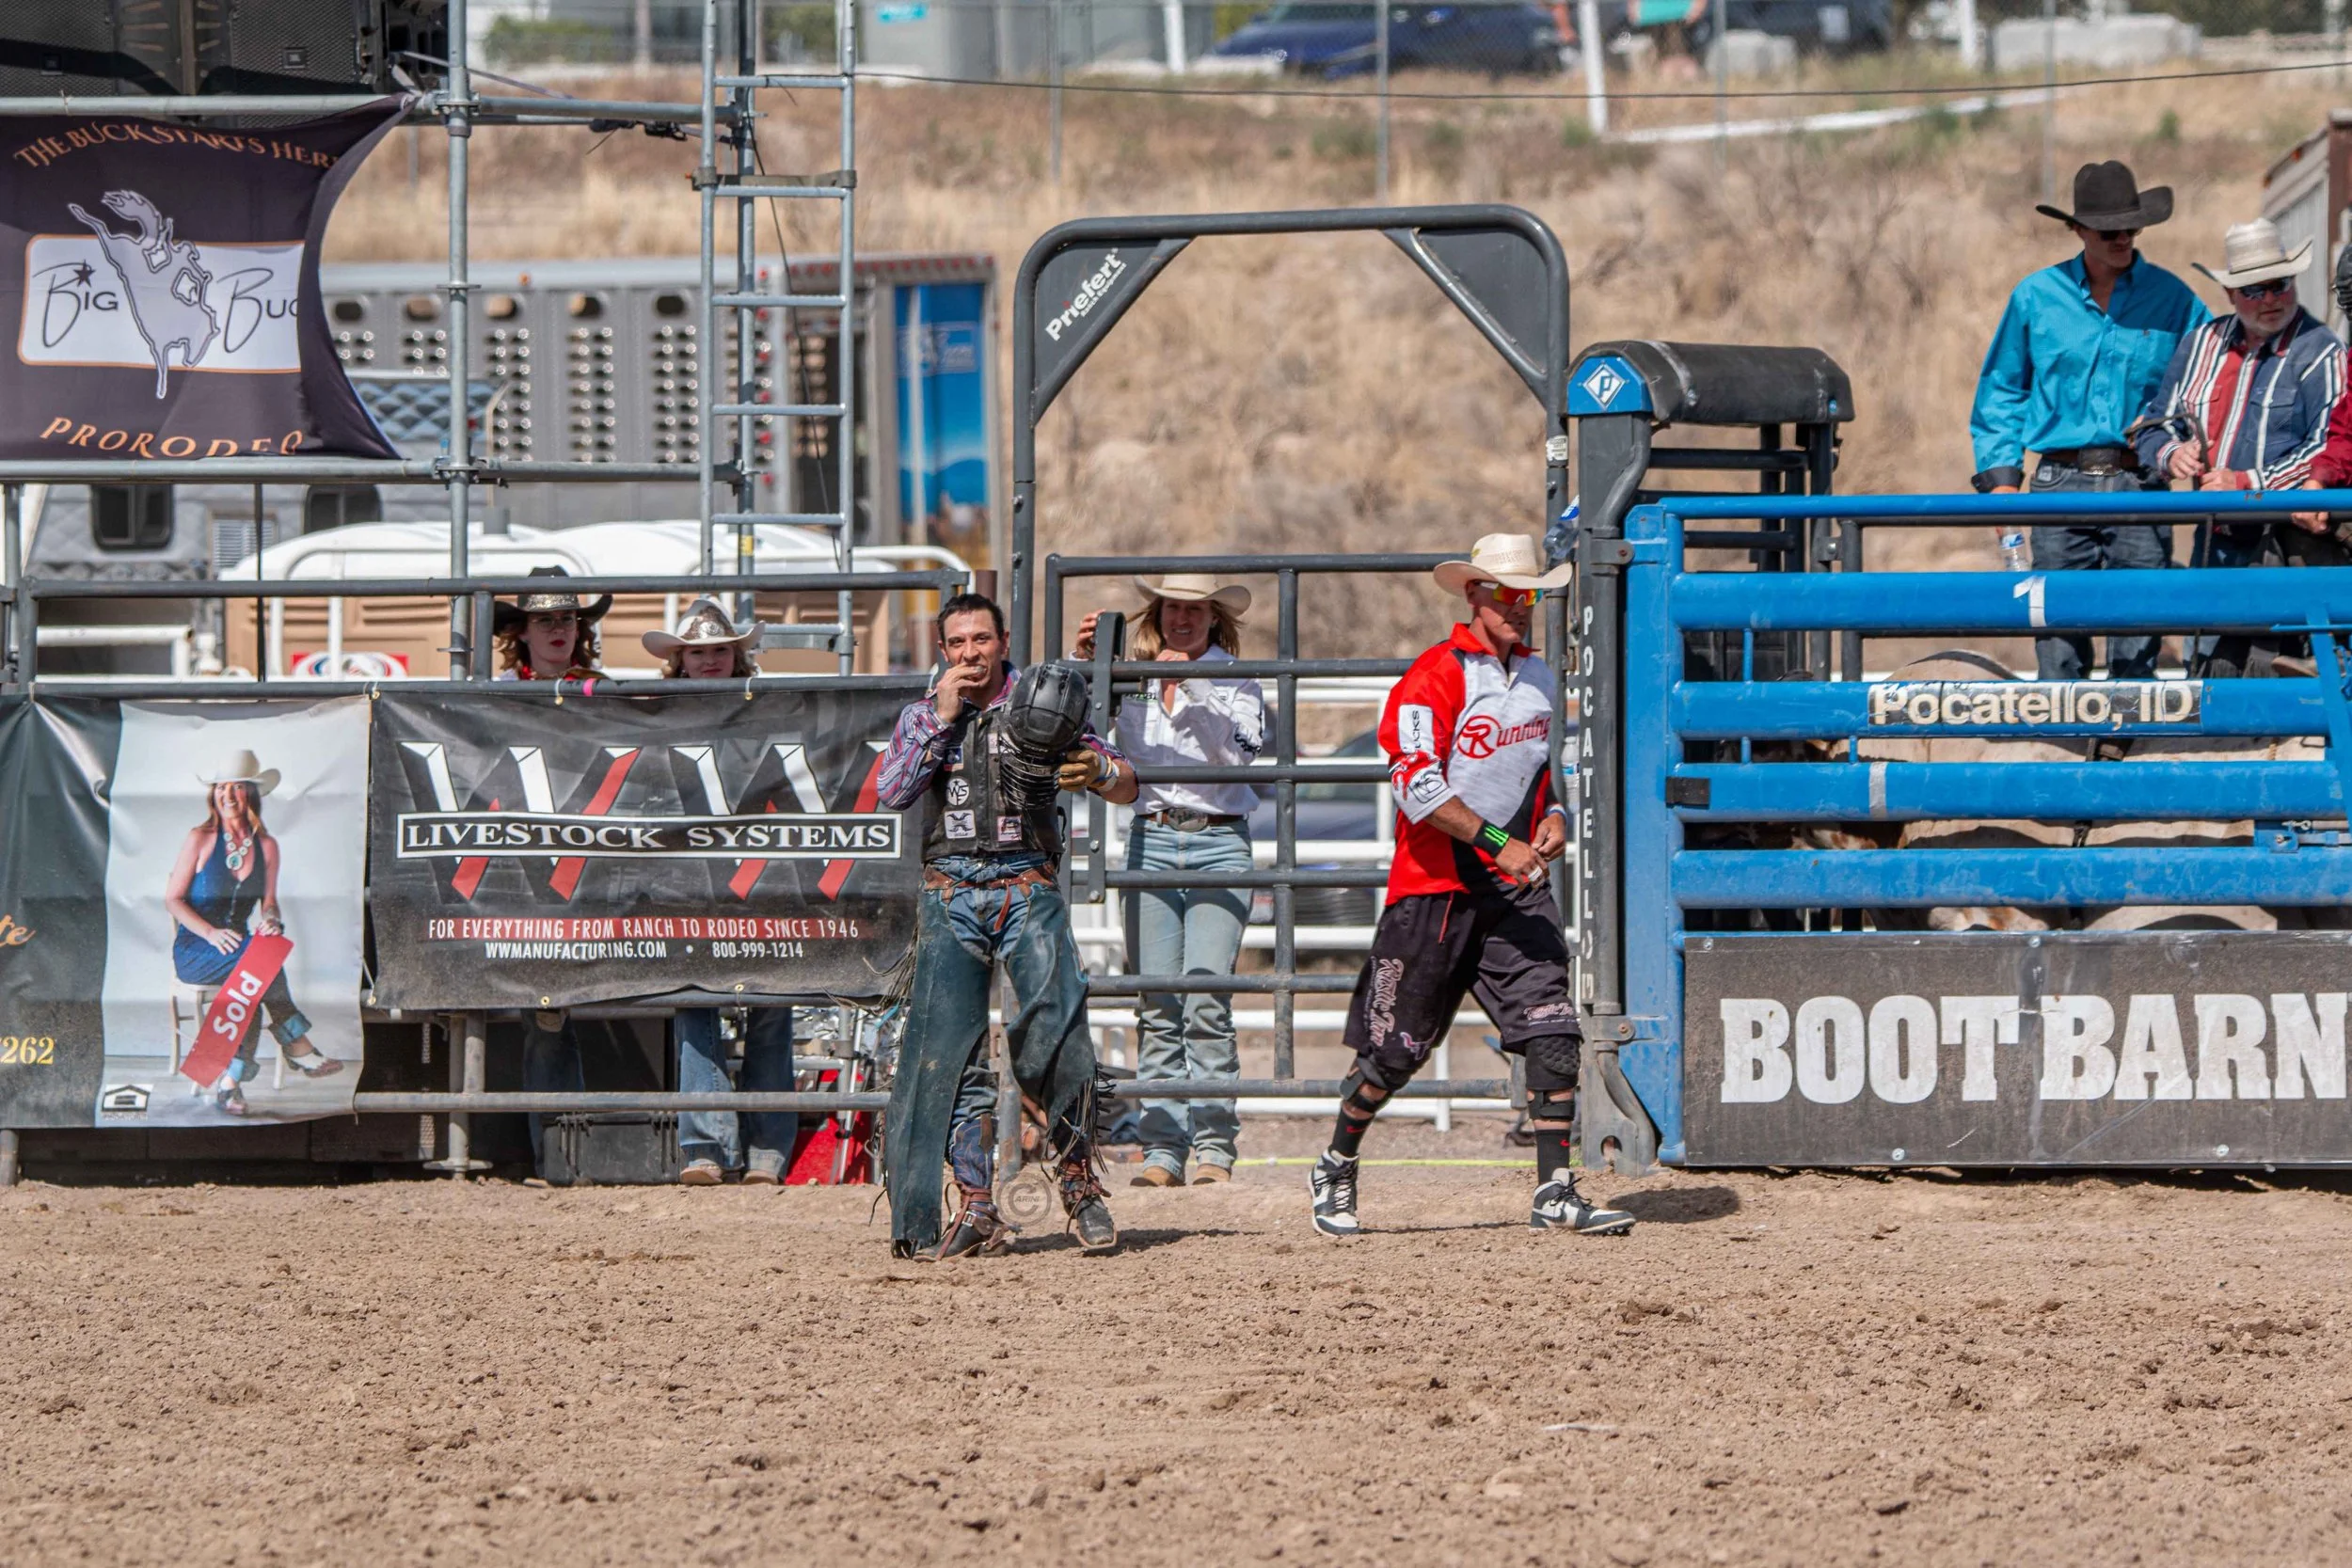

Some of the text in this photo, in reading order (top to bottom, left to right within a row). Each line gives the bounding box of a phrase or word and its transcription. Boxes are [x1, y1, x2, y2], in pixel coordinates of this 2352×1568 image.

[12, 121, 340, 168] THE BUCK STARTS HER
[1044, 252, 1122, 341] Priefert
[2012, 576, 2047, 627] 1
[1873, 682, 2193, 731] Pocatello, ID
[1457, 715, 1551, 759] Running
[405, 822, 891, 848] LIVESTOCK SYSTEMS
[428, 918, 859, 939] FOR EVERYTHING FROM RANCH TO RODEO SINCE 1946
[485, 941, 803, 960] WWMANUFACTURING.COM 800-999-1214
[213, 970, 263, 1042] Sold
[0, 1036, 55, 1065] 262
[1719, 991, 2348, 1104] BOOT BARN
